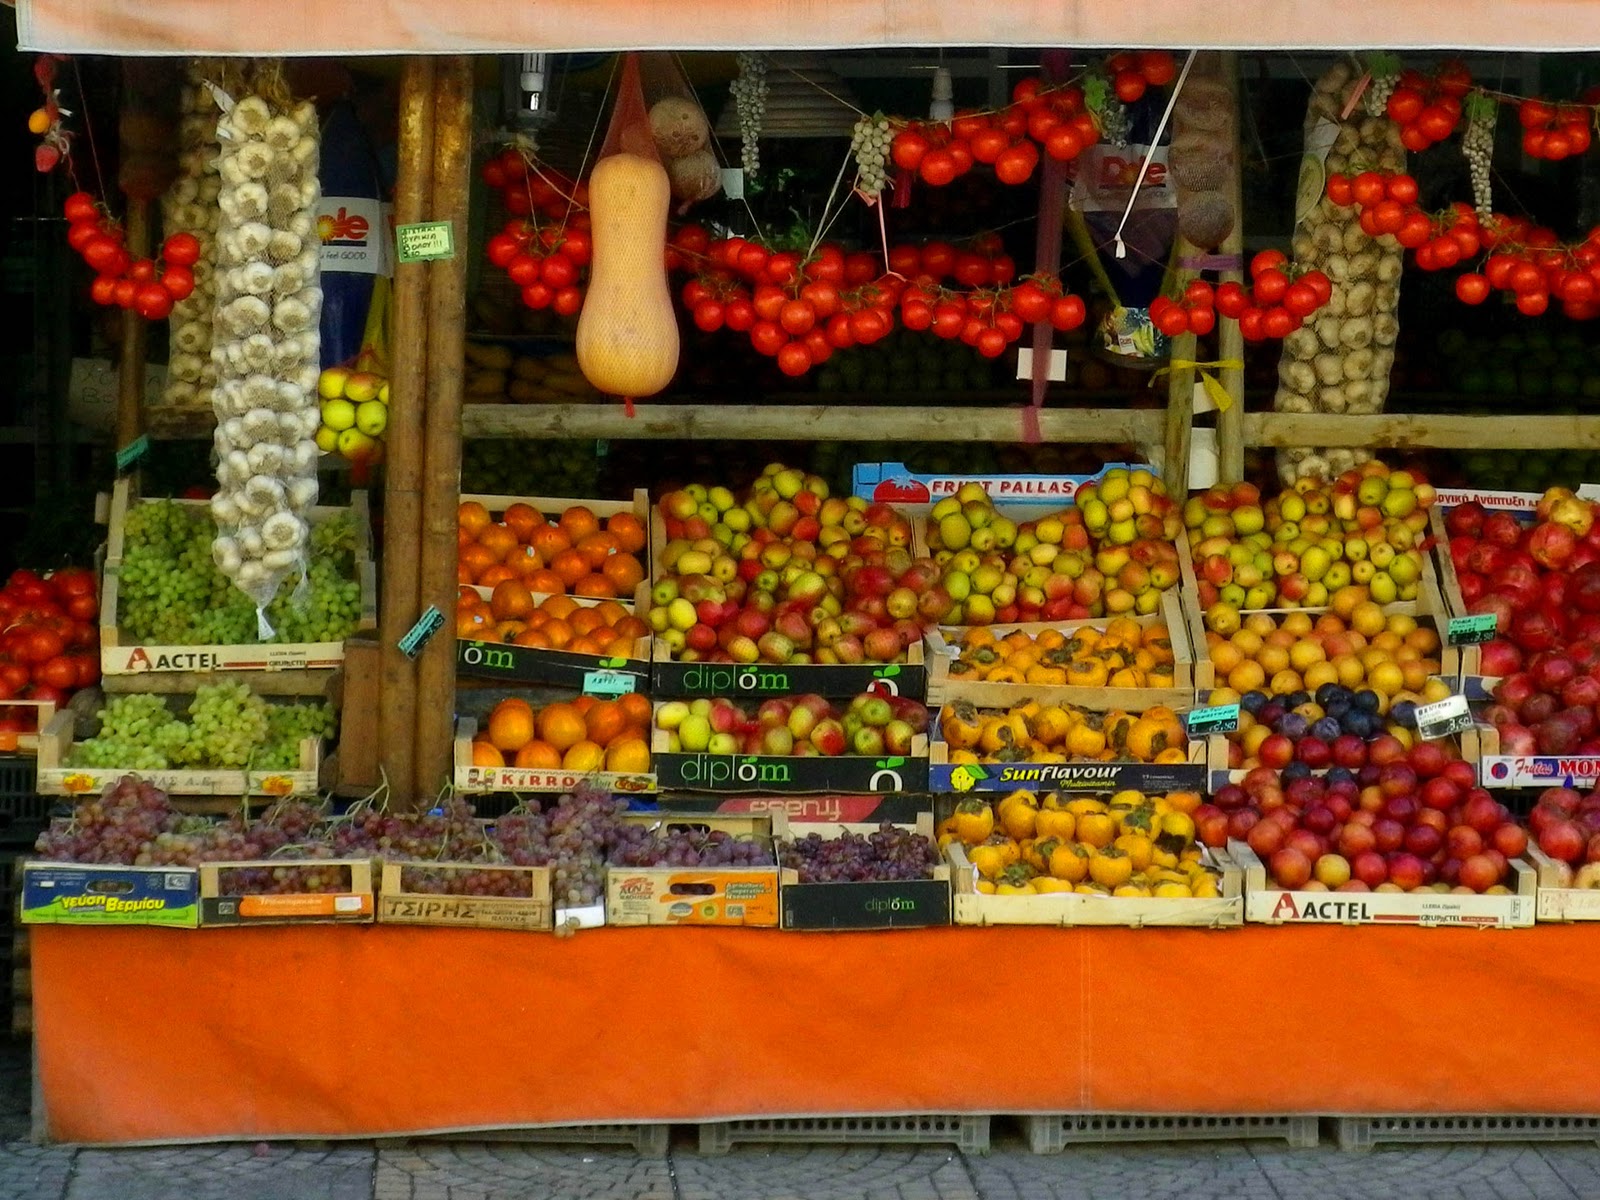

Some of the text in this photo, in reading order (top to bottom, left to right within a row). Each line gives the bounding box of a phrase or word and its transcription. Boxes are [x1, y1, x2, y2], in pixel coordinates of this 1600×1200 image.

[1000, 481, 1074, 494] PALLAS
[156, 653, 221, 669] ACTEL
[1000, 766, 1122, 782] Sunflavour
[1515, 758, 1554, 777] Frutas
[1302, 901, 1371, 920] ACTEL
